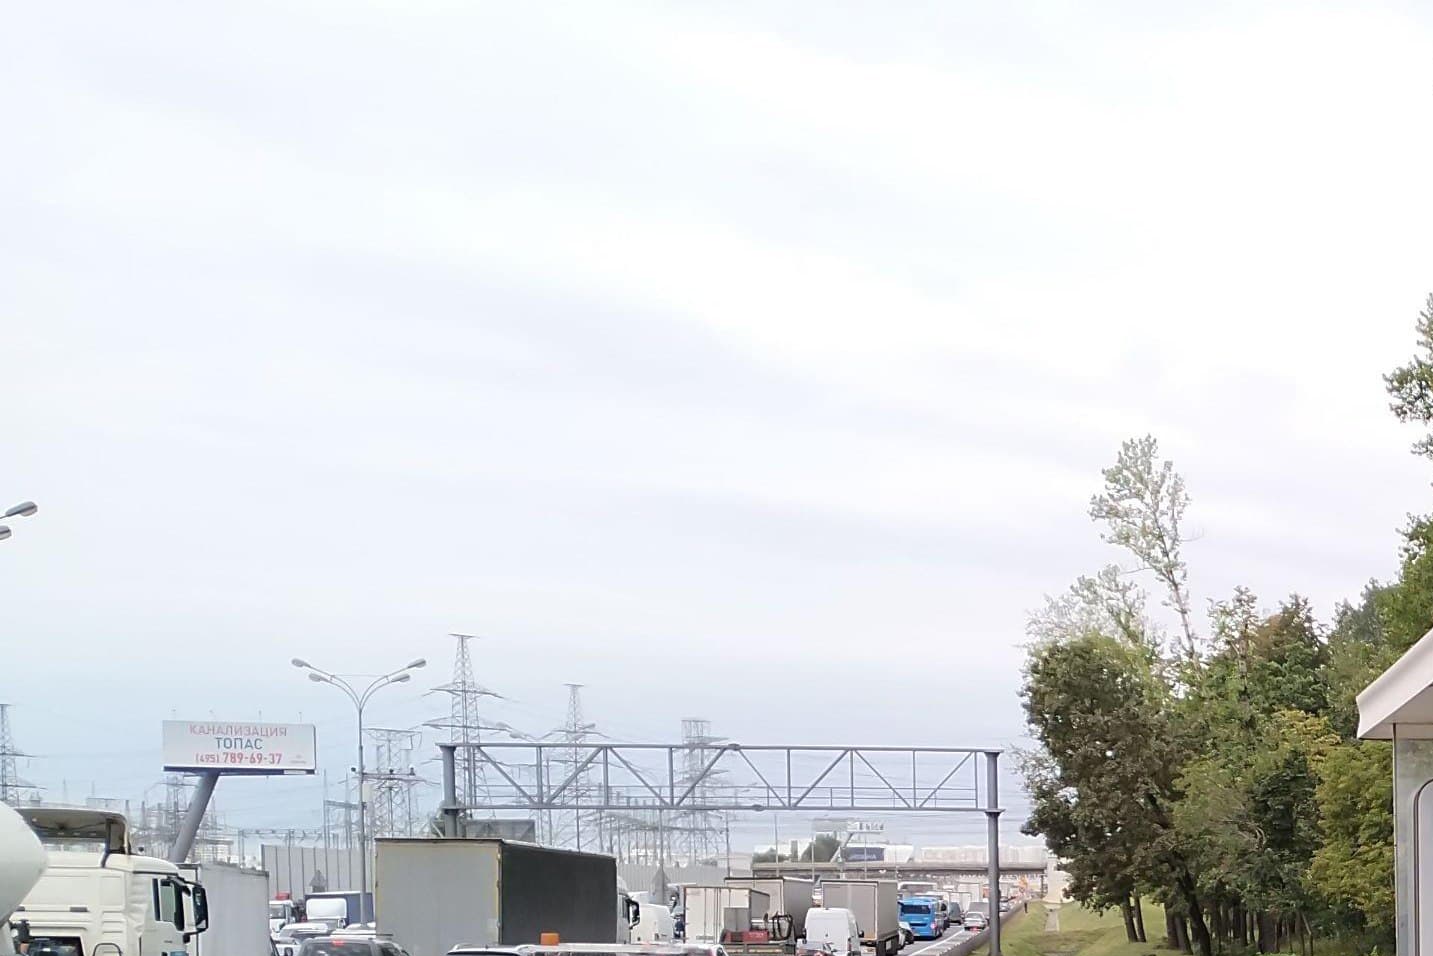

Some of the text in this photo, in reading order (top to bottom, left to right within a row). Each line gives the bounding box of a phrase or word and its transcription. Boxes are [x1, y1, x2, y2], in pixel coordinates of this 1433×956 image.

[189, 724, 287, 737] КАНАЛИЗАЦИЯ
[216, 737, 263, 750] ТОПАС
[195, 752, 283, 765] (495) 789-69-37
